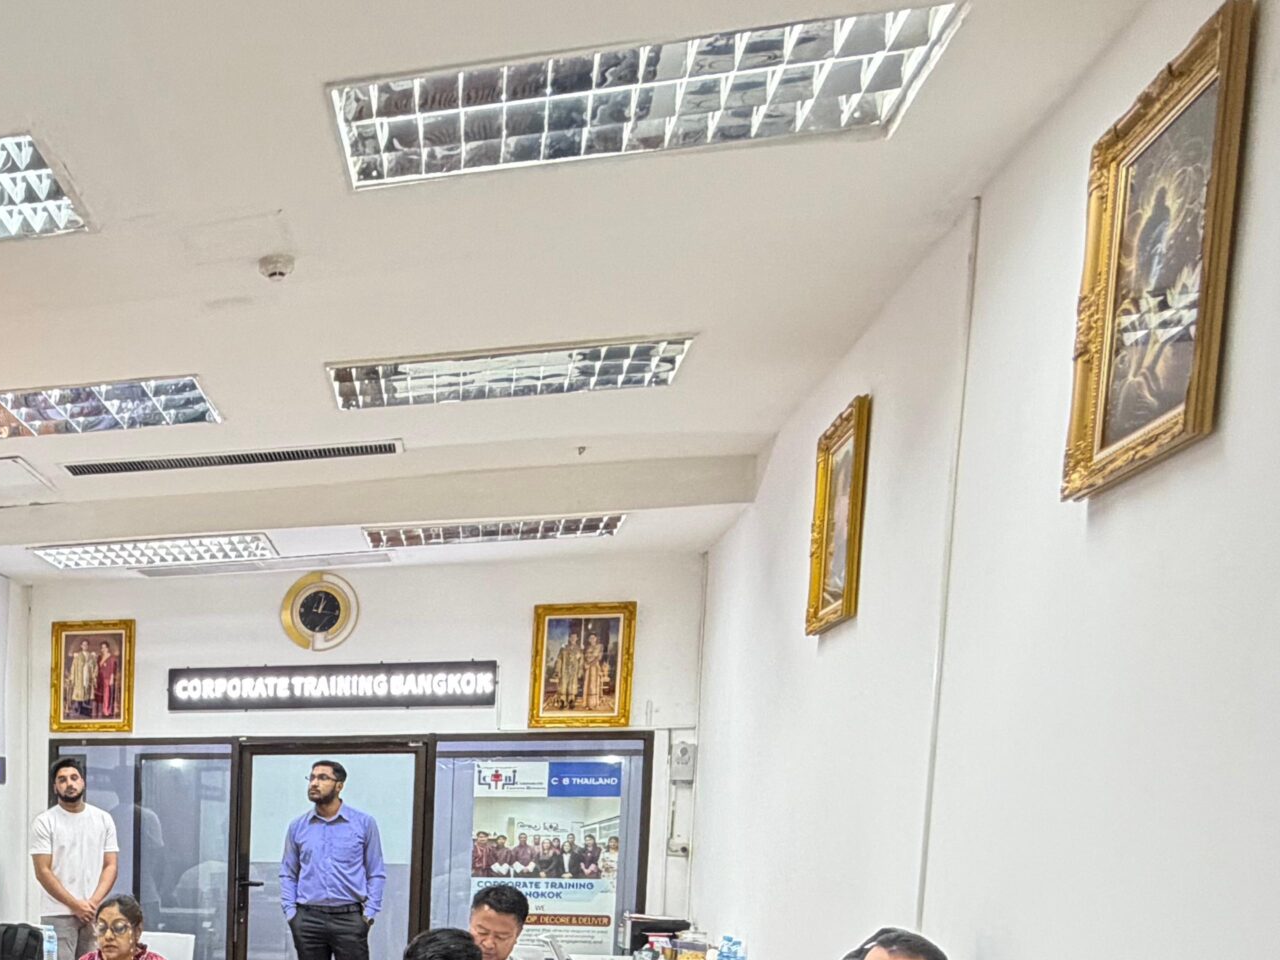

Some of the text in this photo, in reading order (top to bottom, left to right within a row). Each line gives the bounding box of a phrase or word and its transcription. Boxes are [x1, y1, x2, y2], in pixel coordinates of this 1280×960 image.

[175, 672, 494, 700] CORPORATE TRAINING BANGKOK
[572, 777, 618, 785] THAILAND
[545, 882, 594, 890] TRAINING
[525, 891, 562, 899] NGKOK
